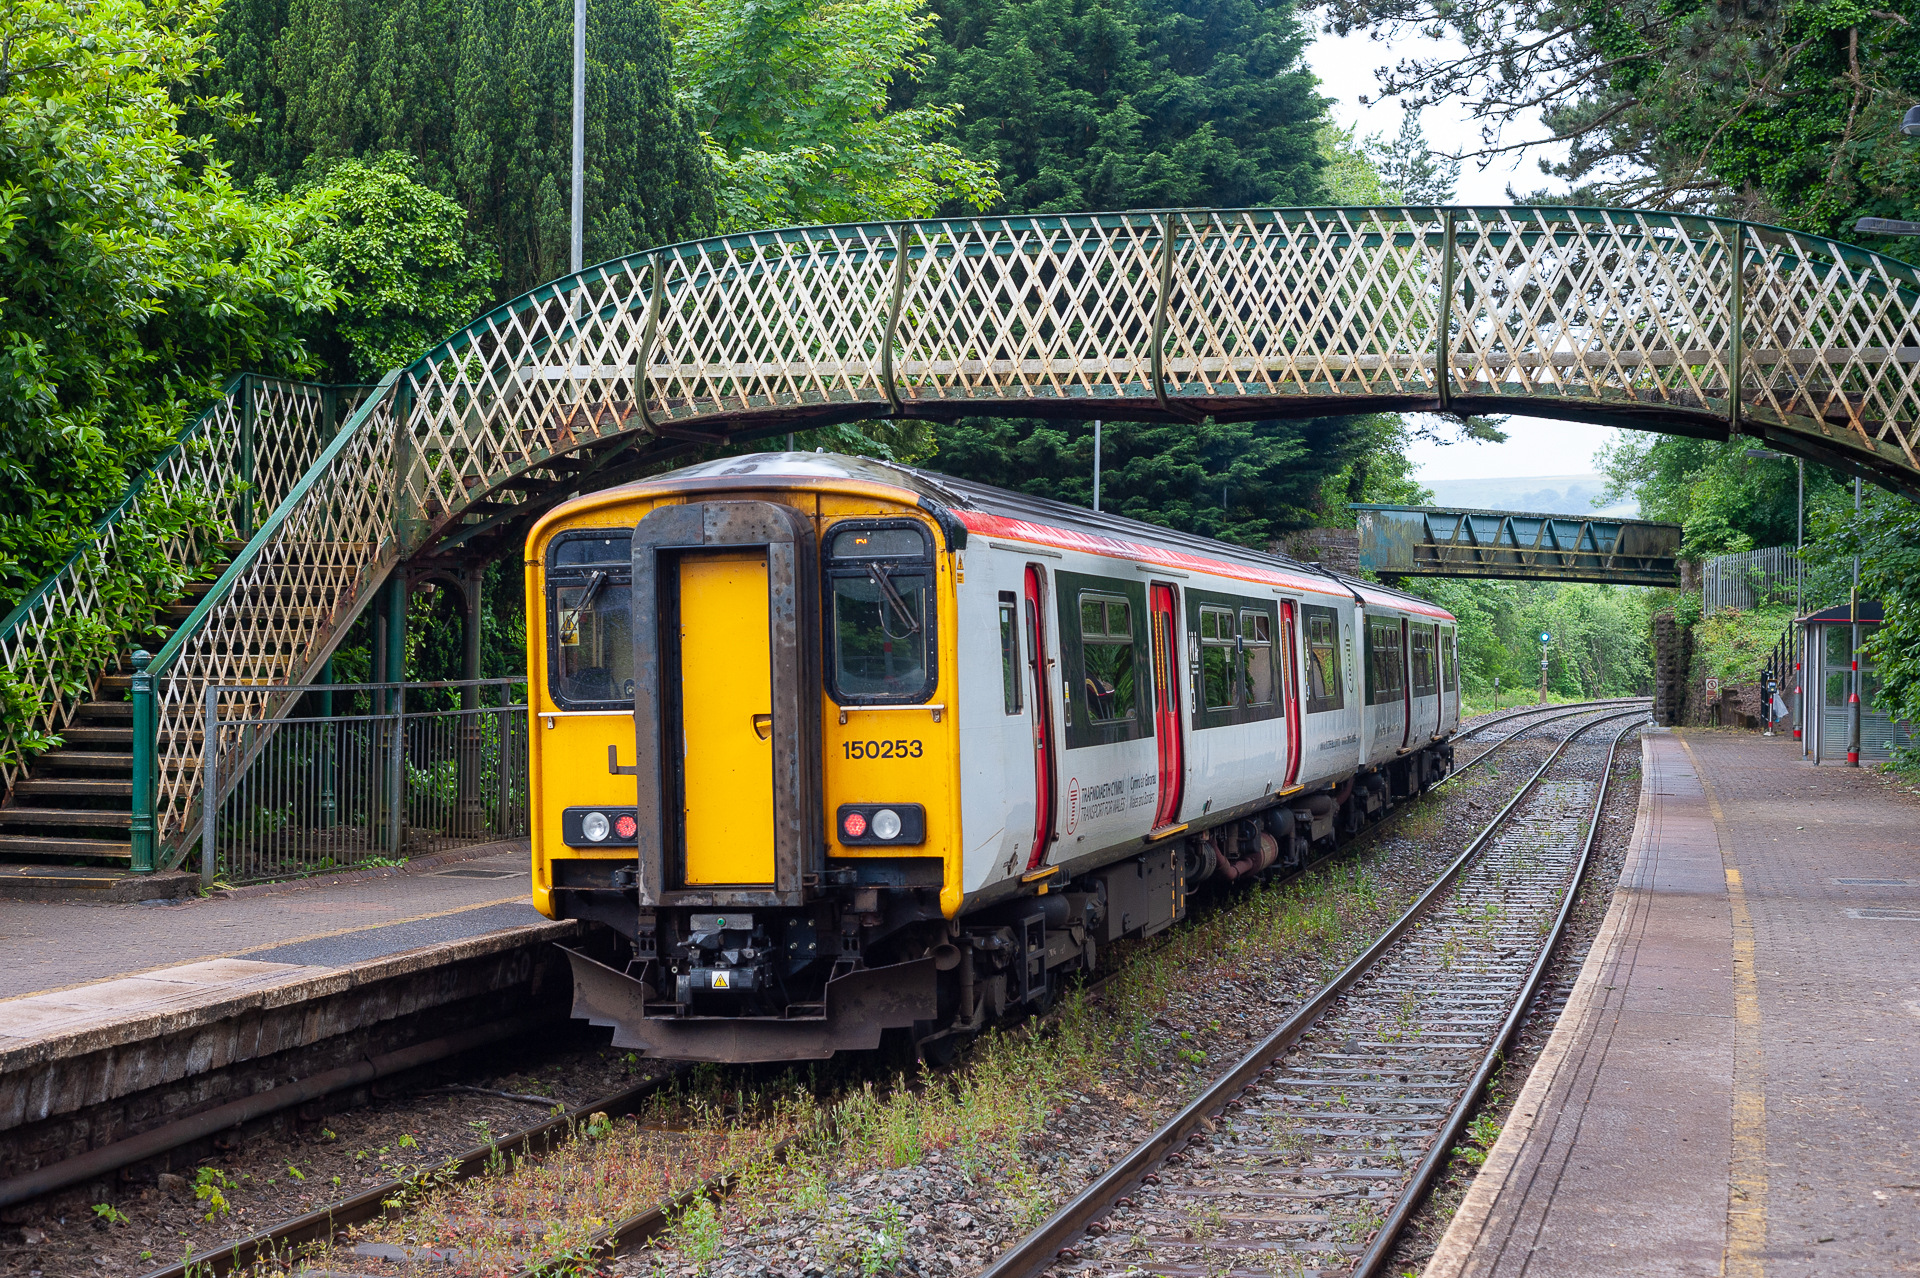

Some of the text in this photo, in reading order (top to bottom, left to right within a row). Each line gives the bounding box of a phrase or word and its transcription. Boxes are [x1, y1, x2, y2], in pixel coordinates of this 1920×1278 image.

[842, 740, 923, 760] 150253
[1081, 802, 1105, 822] TRANSPORT
[1113, 797, 1126, 813] WALES
